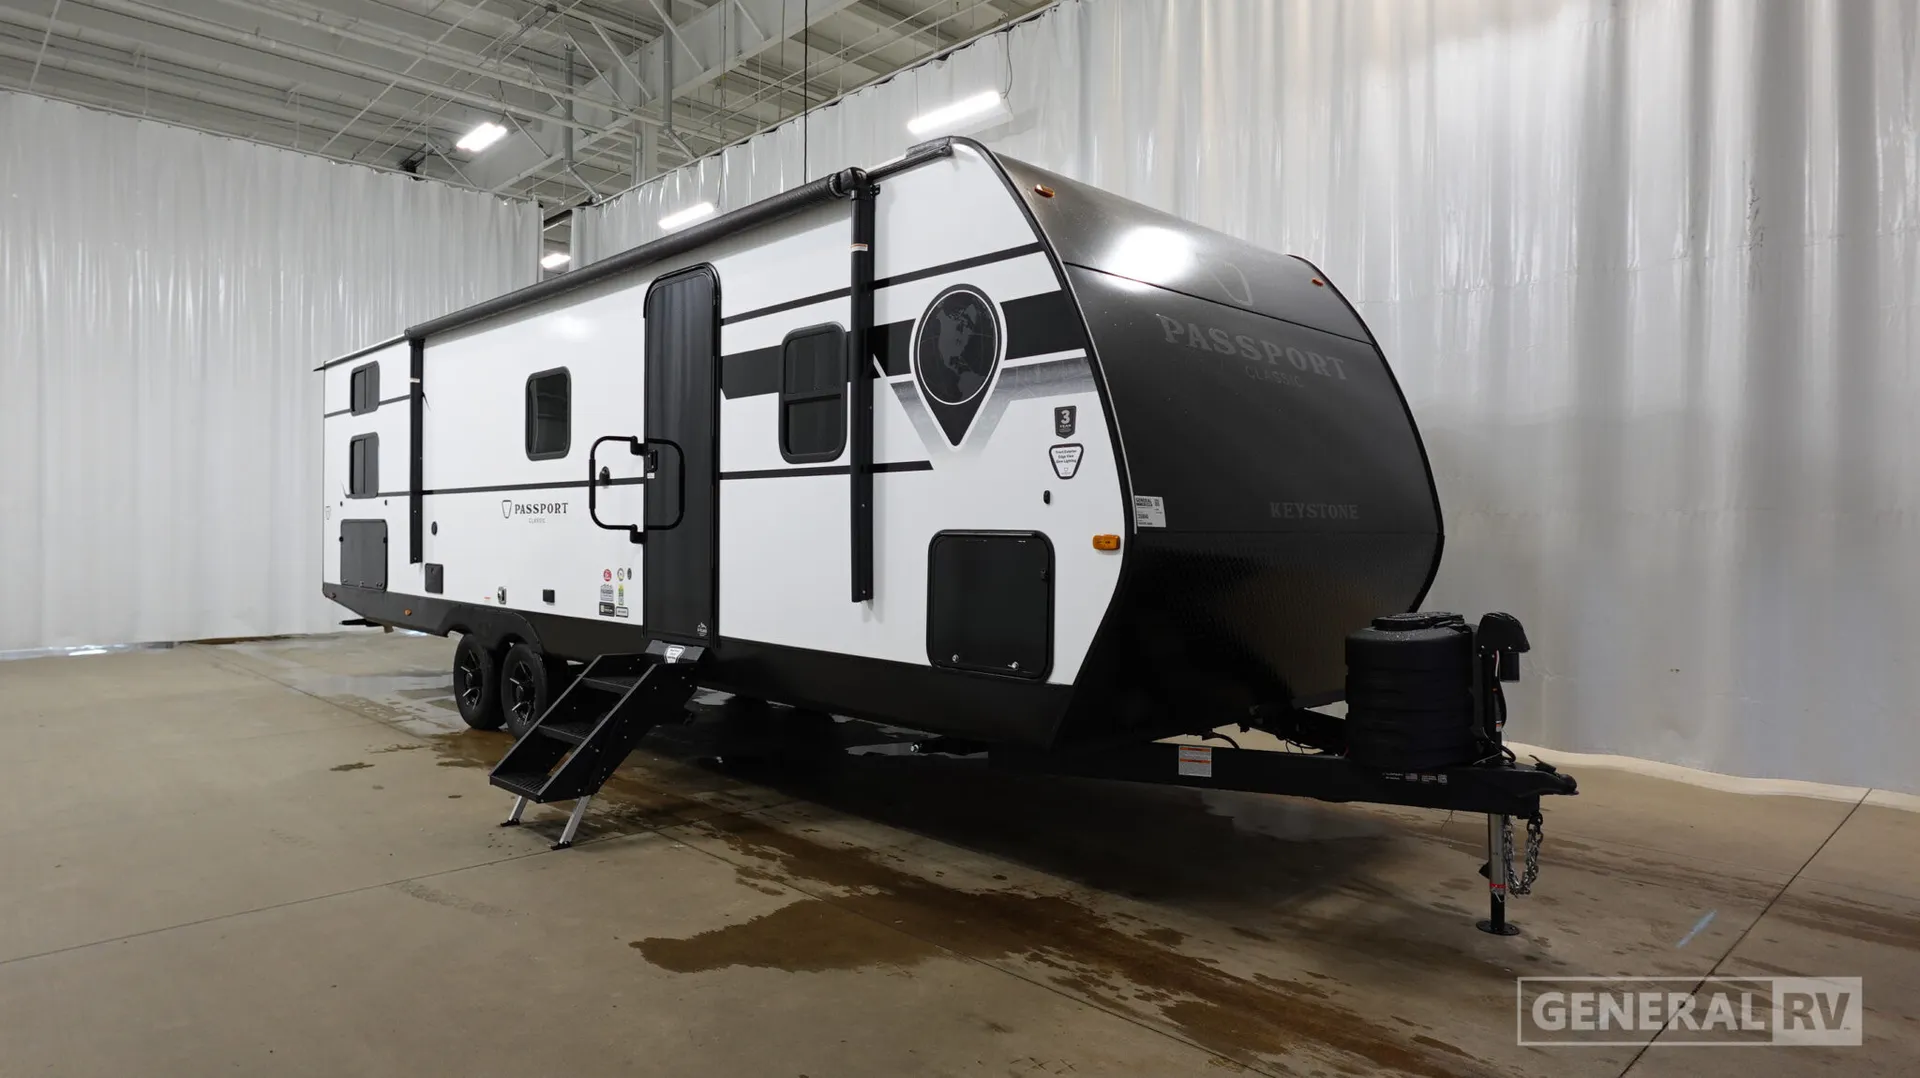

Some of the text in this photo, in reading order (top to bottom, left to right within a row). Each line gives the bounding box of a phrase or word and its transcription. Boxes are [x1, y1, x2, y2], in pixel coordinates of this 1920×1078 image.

[1156, 313, 1347, 380] PASSPORT
[1245, 366, 1304, 388] CLASSIC
[1061, 409, 1070, 424] 3
[515, 502, 569, 515] PASSPORT
[1270, 502, 1360, 519] KEYSTONE
